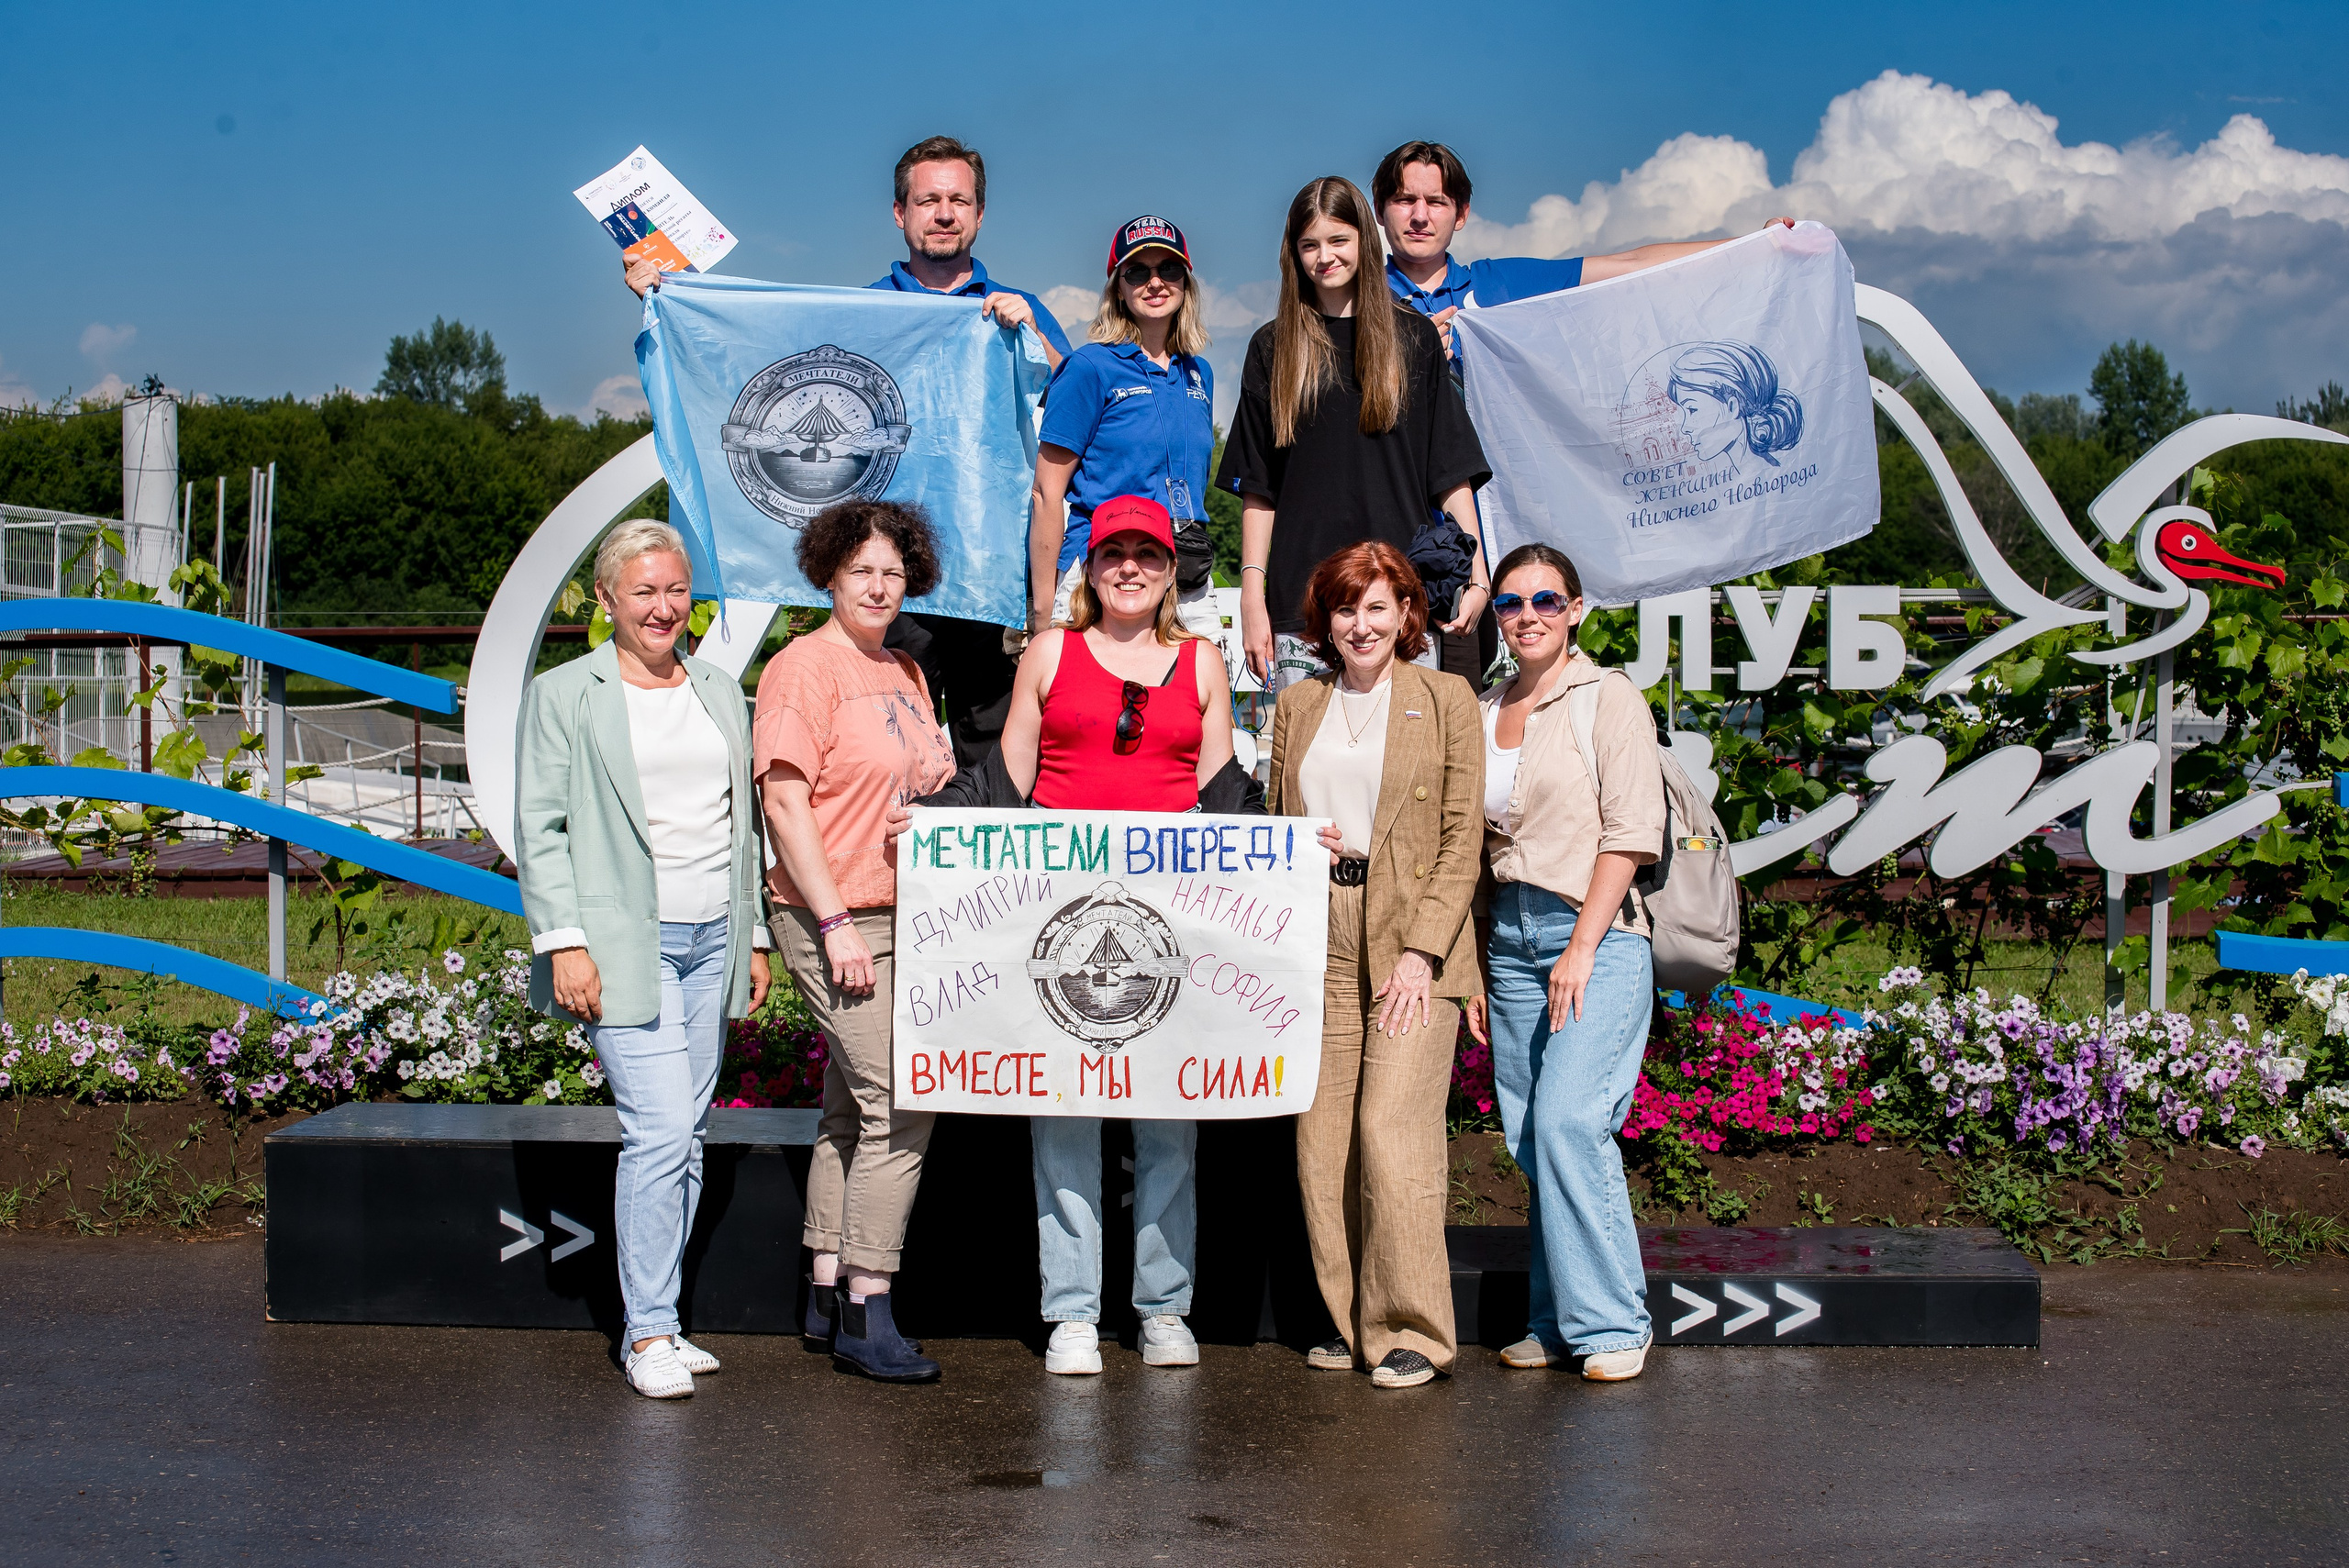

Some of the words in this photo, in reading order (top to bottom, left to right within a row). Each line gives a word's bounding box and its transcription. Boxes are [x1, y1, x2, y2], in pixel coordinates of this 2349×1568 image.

[1128, 226, 1174, 241] RUSSIA
[1134, 217, 1166, 228] TEAM
[787, 369, 860, 385] МЕЧТАТЕЛИ
[1622, 461, 1688, 487] СОВЕТ
[1626, 498, 1720, 529] Нижнего
[1723, 462, 1820, 506] Новгорода
[1634, 465, 1735, 506] ЖЕНЩИН
[770, 495, 807, 516] Нижний
[1587, 584, 1908, 691] ЛУБ
[910, 823, 1109, 875] МЕЧТАТЕЛИ
[1126, 823, 1294, 875] ВПЕРЕД!
[912, 873, 1052, 953] ДМИТРИЙ
[1086, 909, 1133, 923] МЕЧТАТЕЛИ
[1171, 877, 1292, 946] НАТАЛЬЯ
[909, 962, 999, 1027] ВЛАД
[1190, 953, 1300, 1039] СОФИЯ
[1080, 1052, 1132, 1099] МЫ
[1178, 1055, 1285, 1100] СИЛА!
